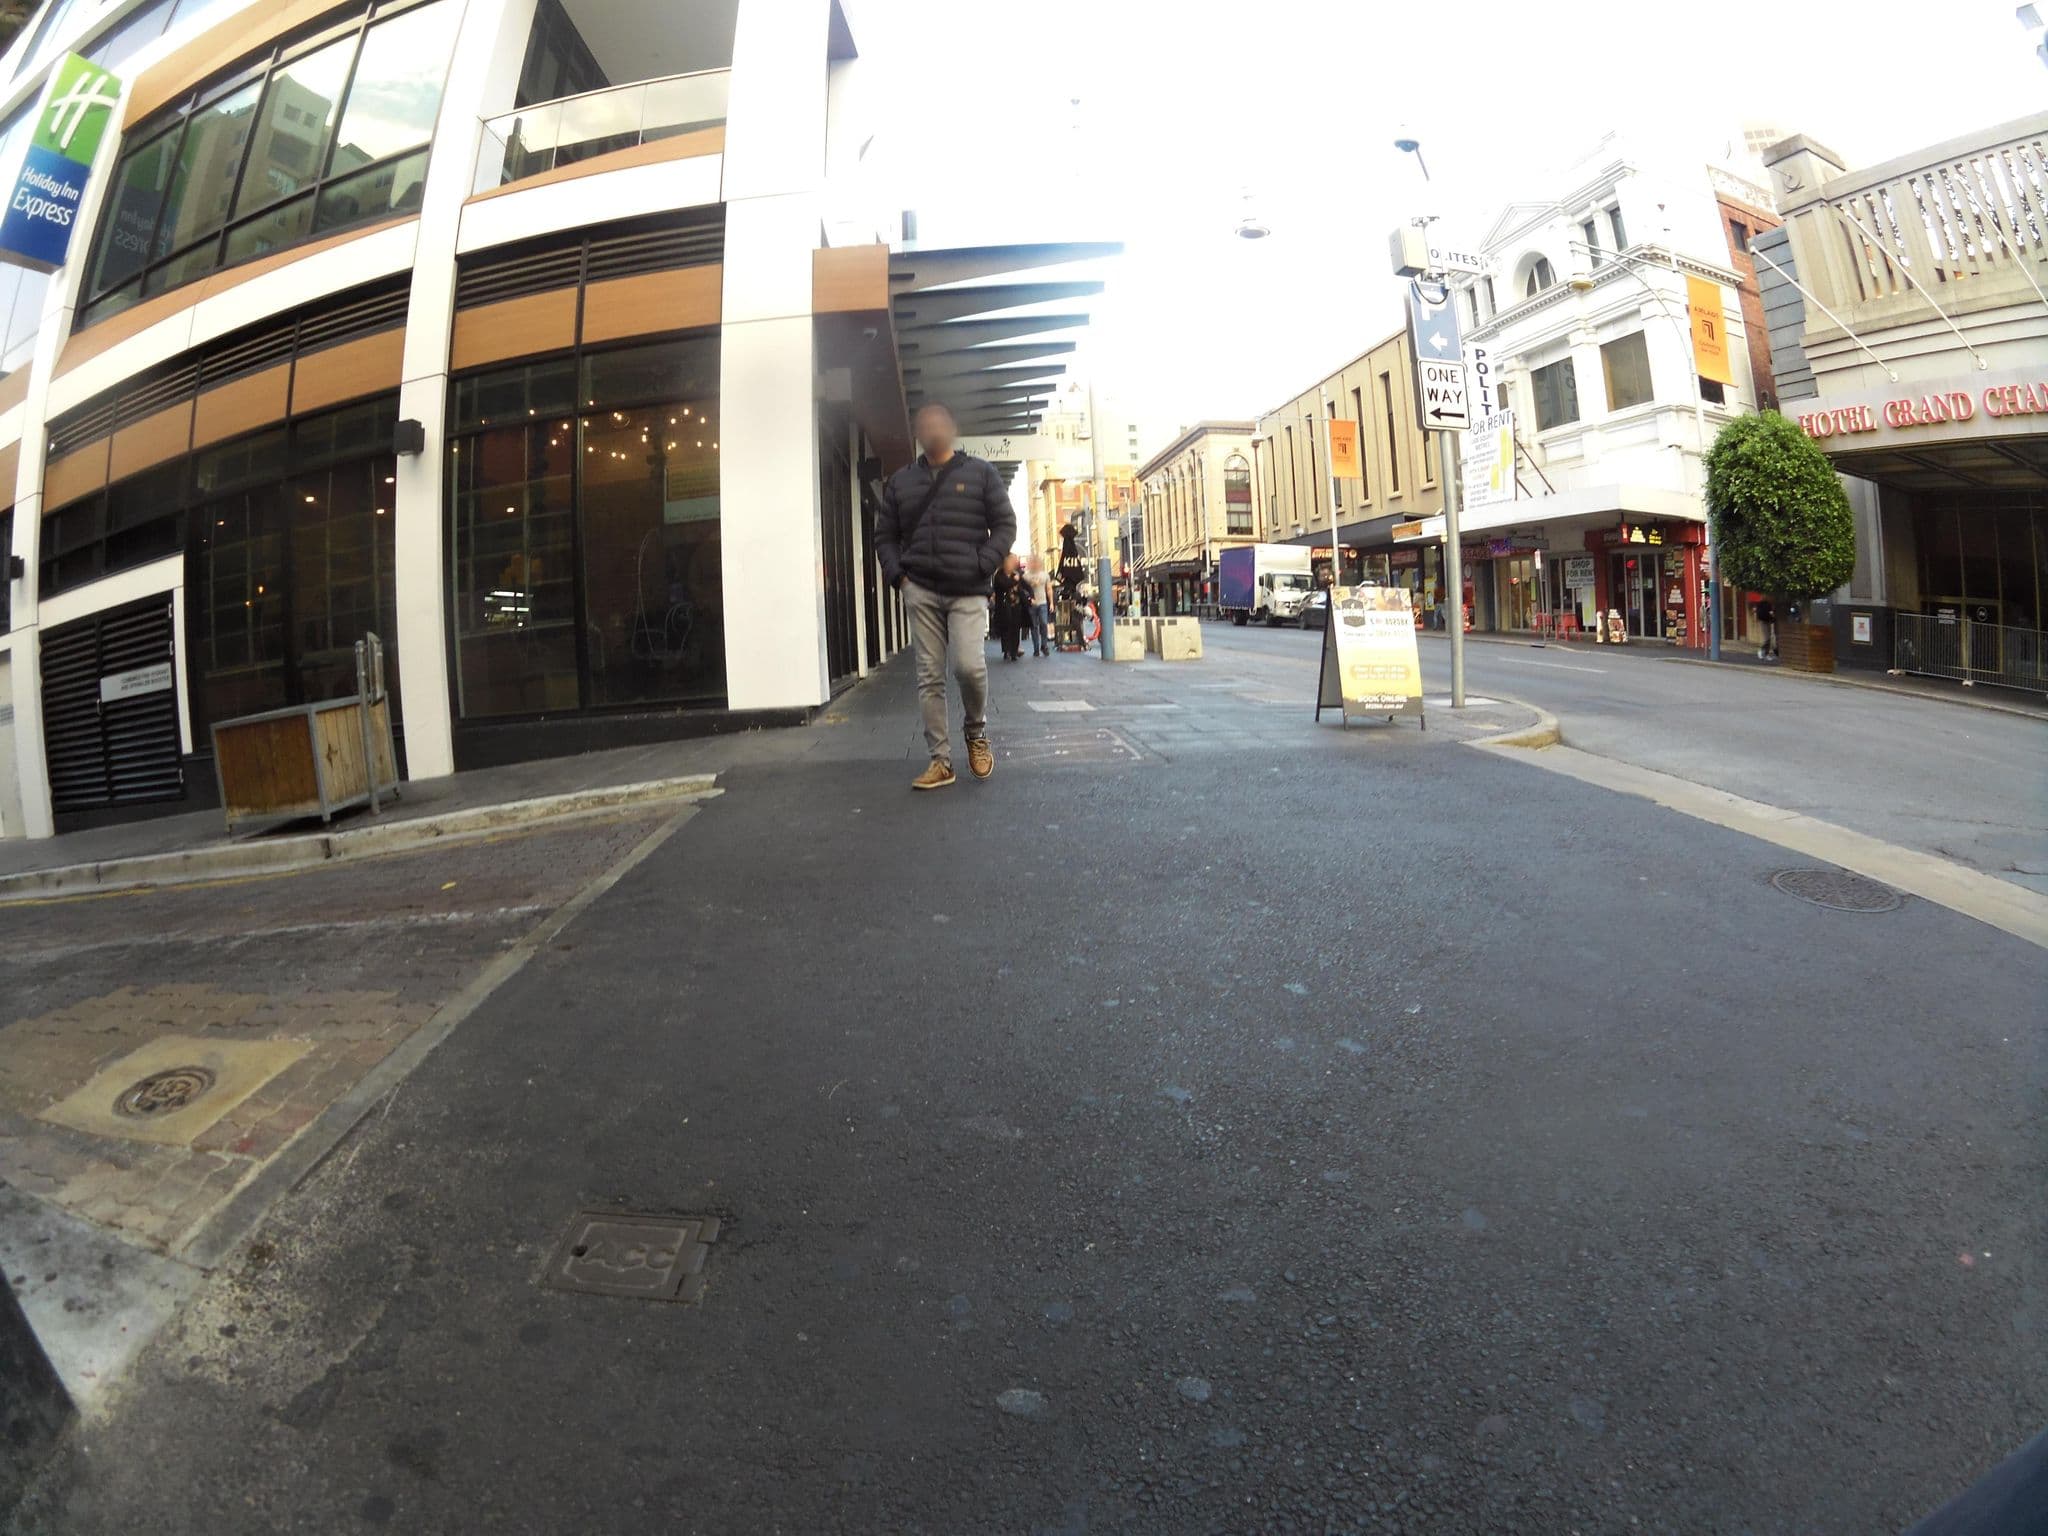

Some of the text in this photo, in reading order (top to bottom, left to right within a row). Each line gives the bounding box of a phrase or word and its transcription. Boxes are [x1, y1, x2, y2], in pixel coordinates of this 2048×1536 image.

[22, 166, 79, 200] Holiday Inn
[12, 187, 73, 226] Express
[1427, 367, 1460, 384] ONE
[1475, 348, 1492, 416] POLIT
[1427, 386, 1463, 405] WAY
[1487, 410, 1512, 431] RENT
[1798, 405, 1878, 438] HOTEL
[1882, 391, 1976, 428] GRAND
[1571, 560, 1591, 569] SHOP
